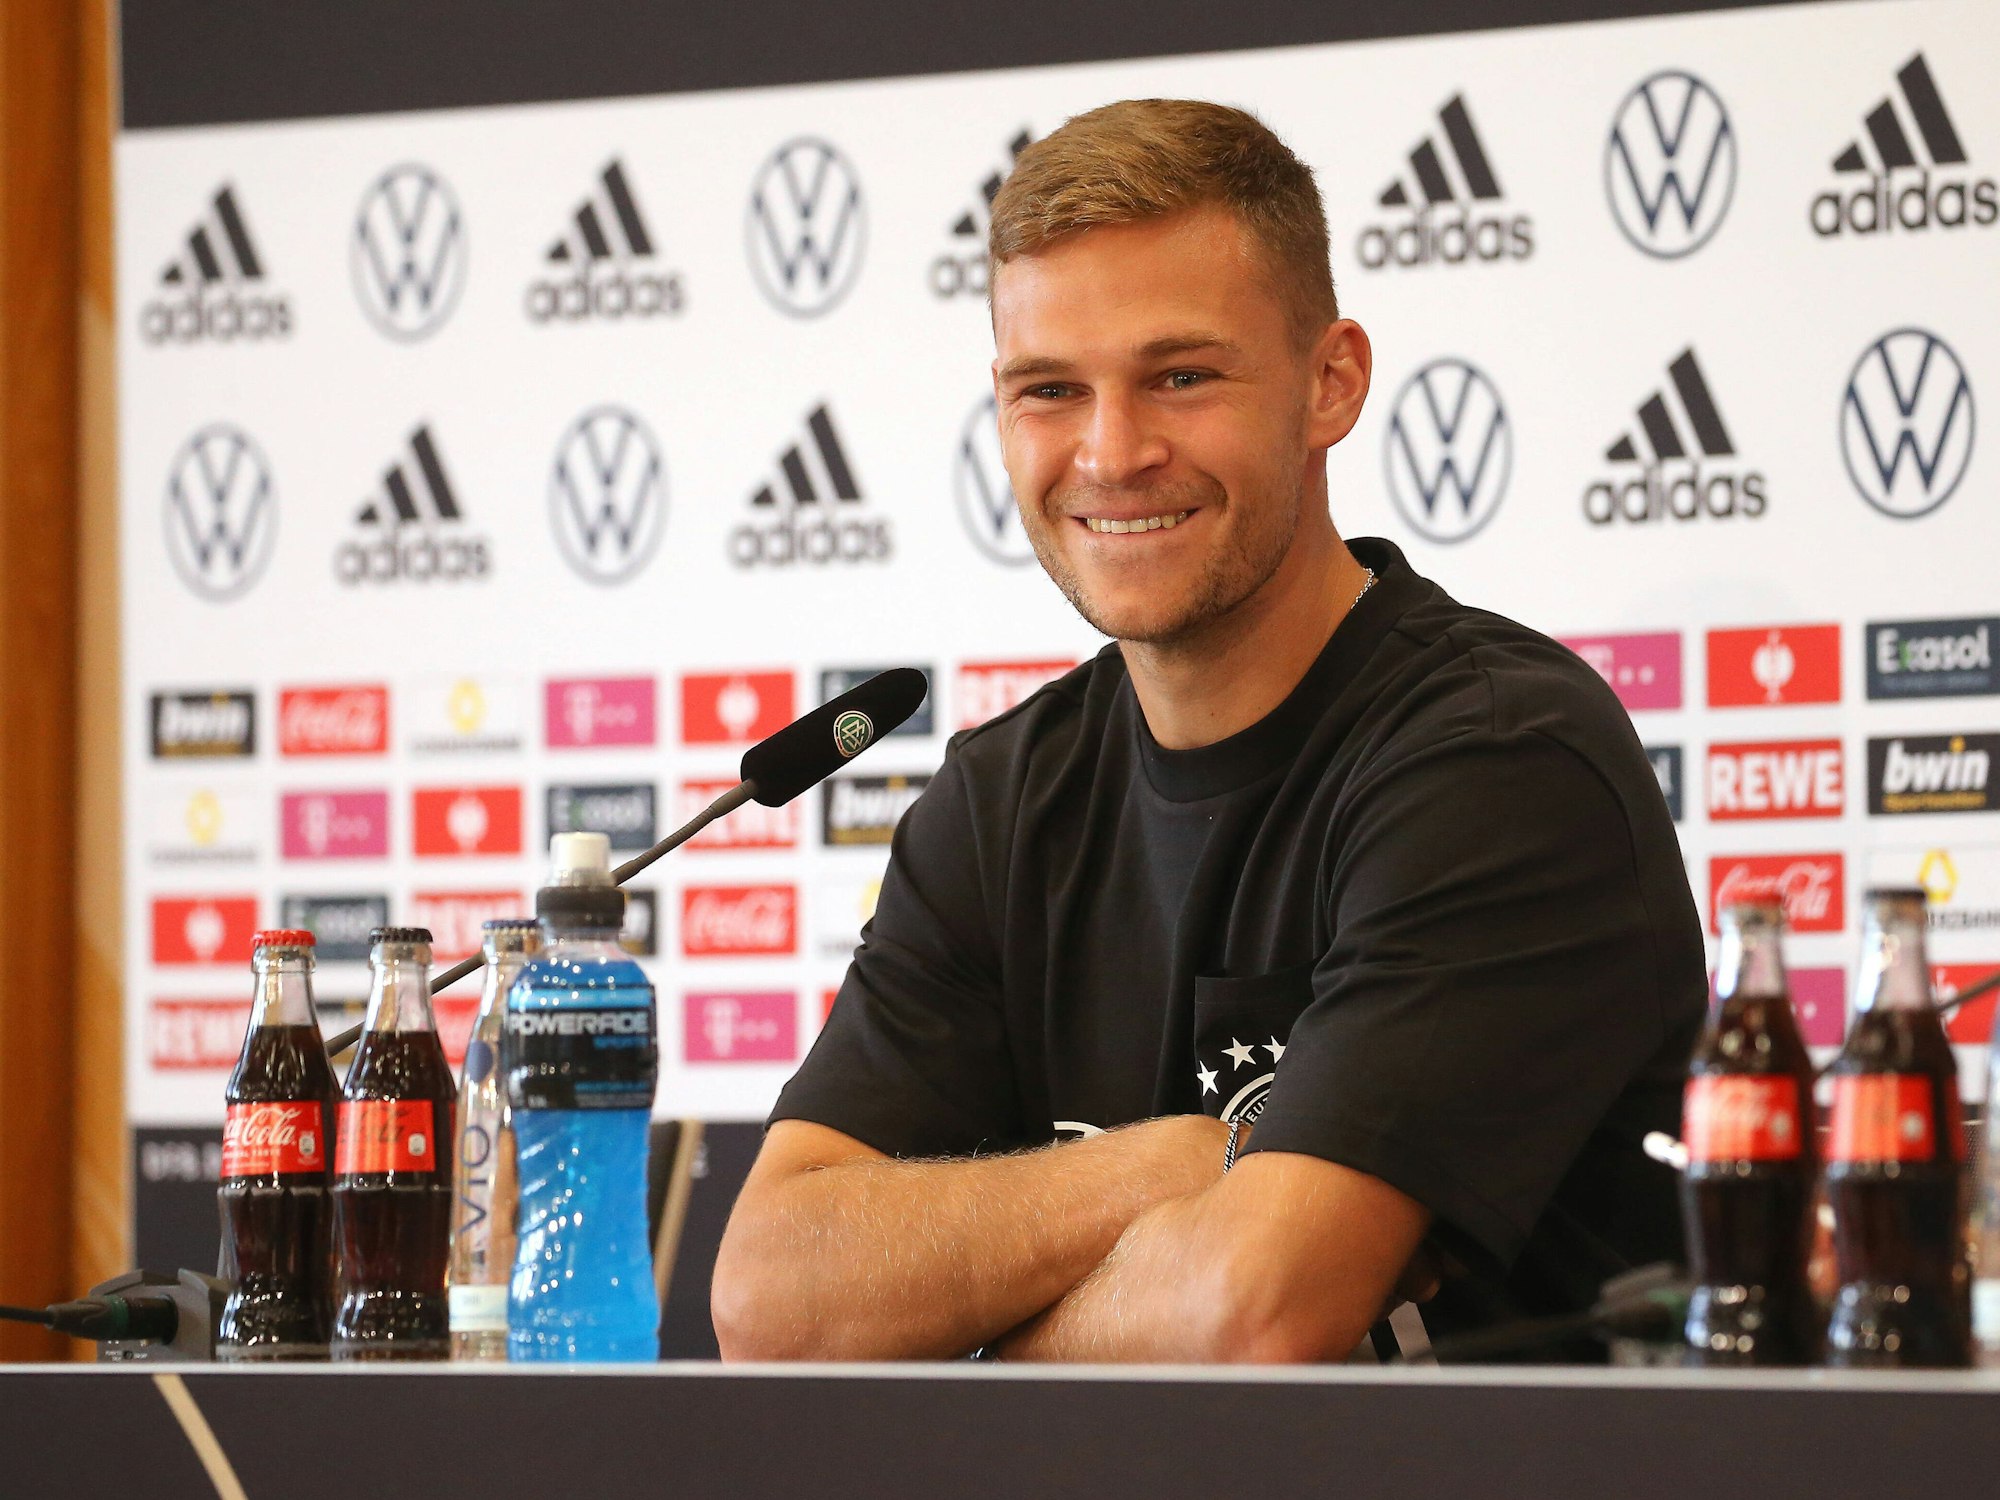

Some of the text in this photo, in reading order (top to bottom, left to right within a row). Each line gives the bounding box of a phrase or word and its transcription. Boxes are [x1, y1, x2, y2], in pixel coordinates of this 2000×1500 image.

[1810, 168, 1999, 238] adidas
[1357, 208, 1534, 269] adidas
[140, 292, 292, 345] adidas
[525, 268, 686, 324] adidas
[1582, 462, 1768, 527] adidas
[335, 528, 491, 586] adidas
[726, 511, 892, 567] adidas
[1877, 625, 1991, 673] Exasol
[1709, 751, 1842, 811] REWE
[1883, 736, 1990, 793] bwin
[508, 1012, 648, 1036] POWERADE
[460, 1125, 490, 1235] VIO
